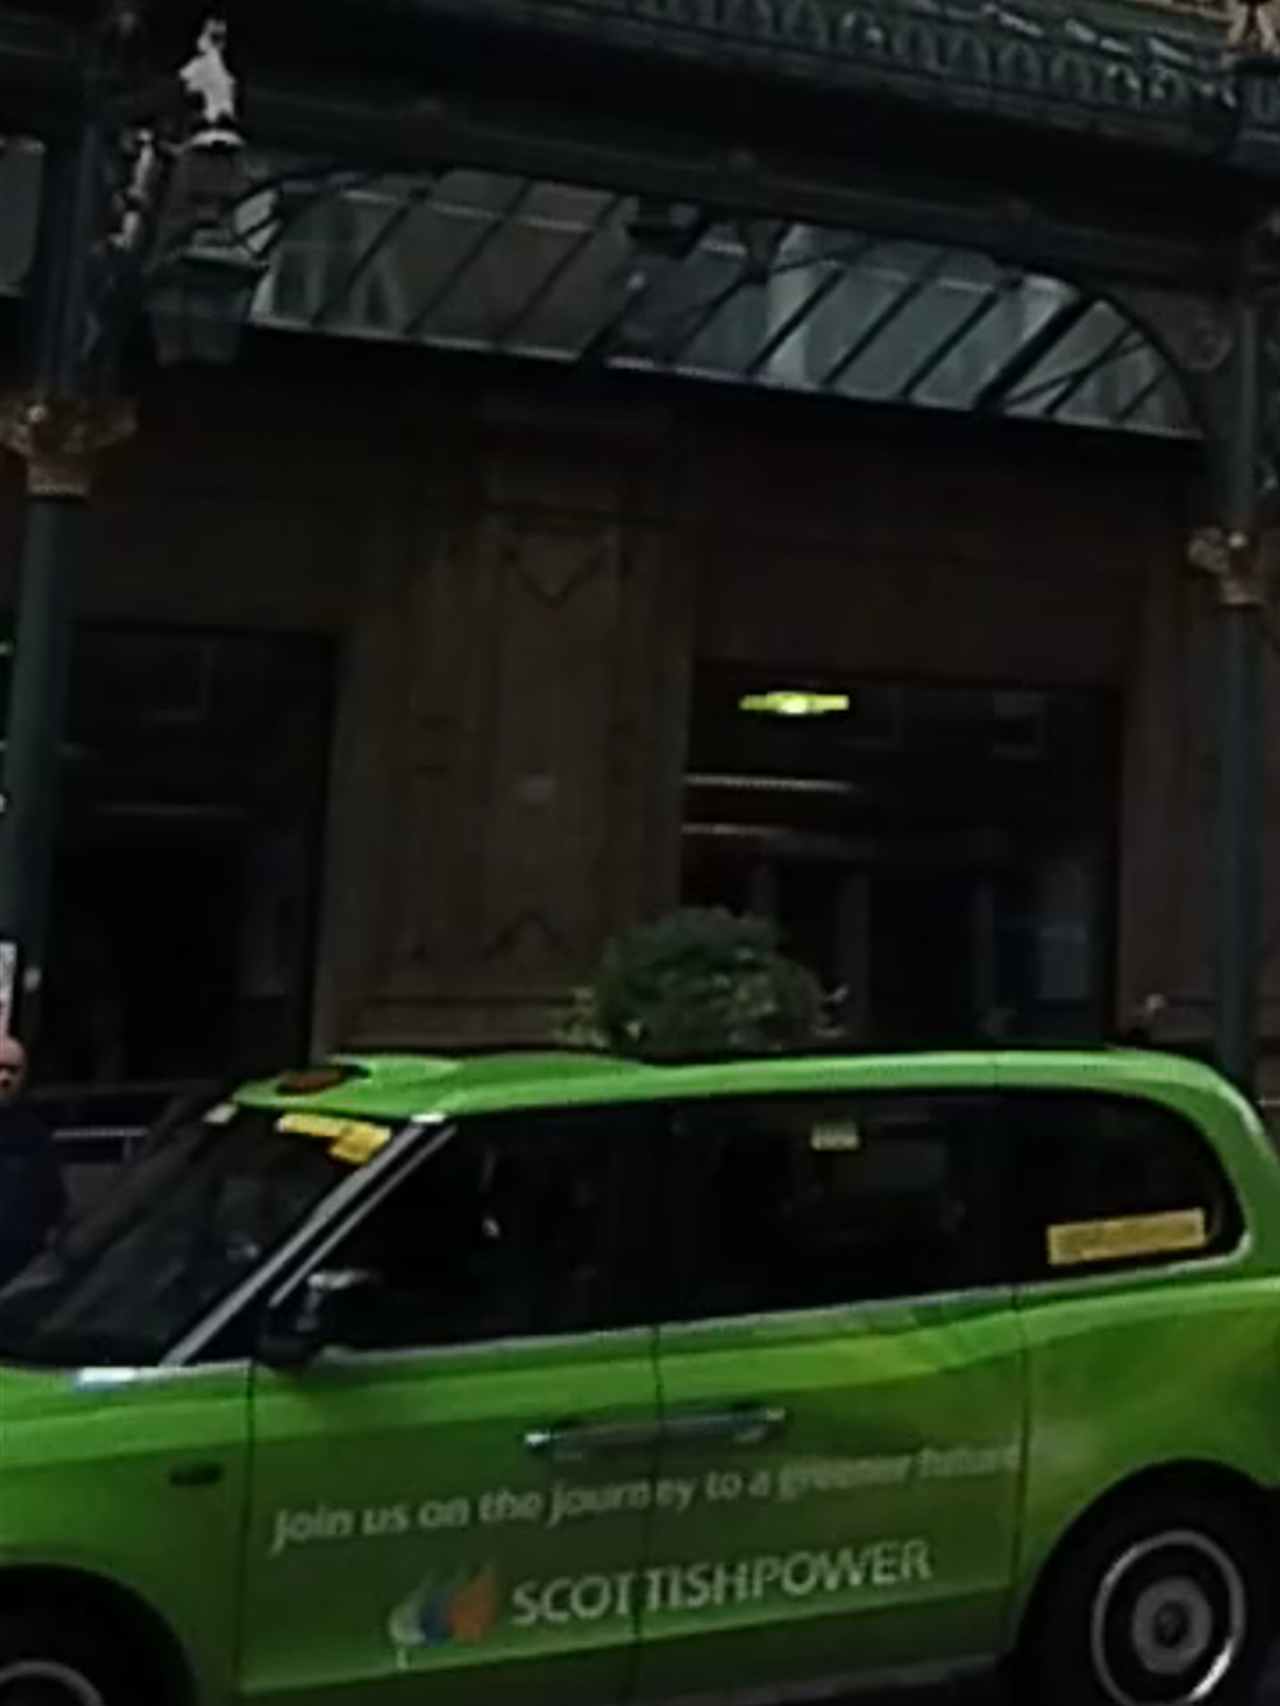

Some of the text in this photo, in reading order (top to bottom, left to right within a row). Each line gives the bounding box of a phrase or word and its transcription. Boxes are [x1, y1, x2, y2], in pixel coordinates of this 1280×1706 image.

[362, 1504, 409, 1535] us
[418, 1496, 469, 1529] on
[479, 1487, 542, 1523] the
[548, 1479, 698, 1527] journey
[706, 1470, 742, 1502] to
[748, 1469, 771, 1497] a
[511, 1538, 932, 1626] SCOTTISHPOWER
